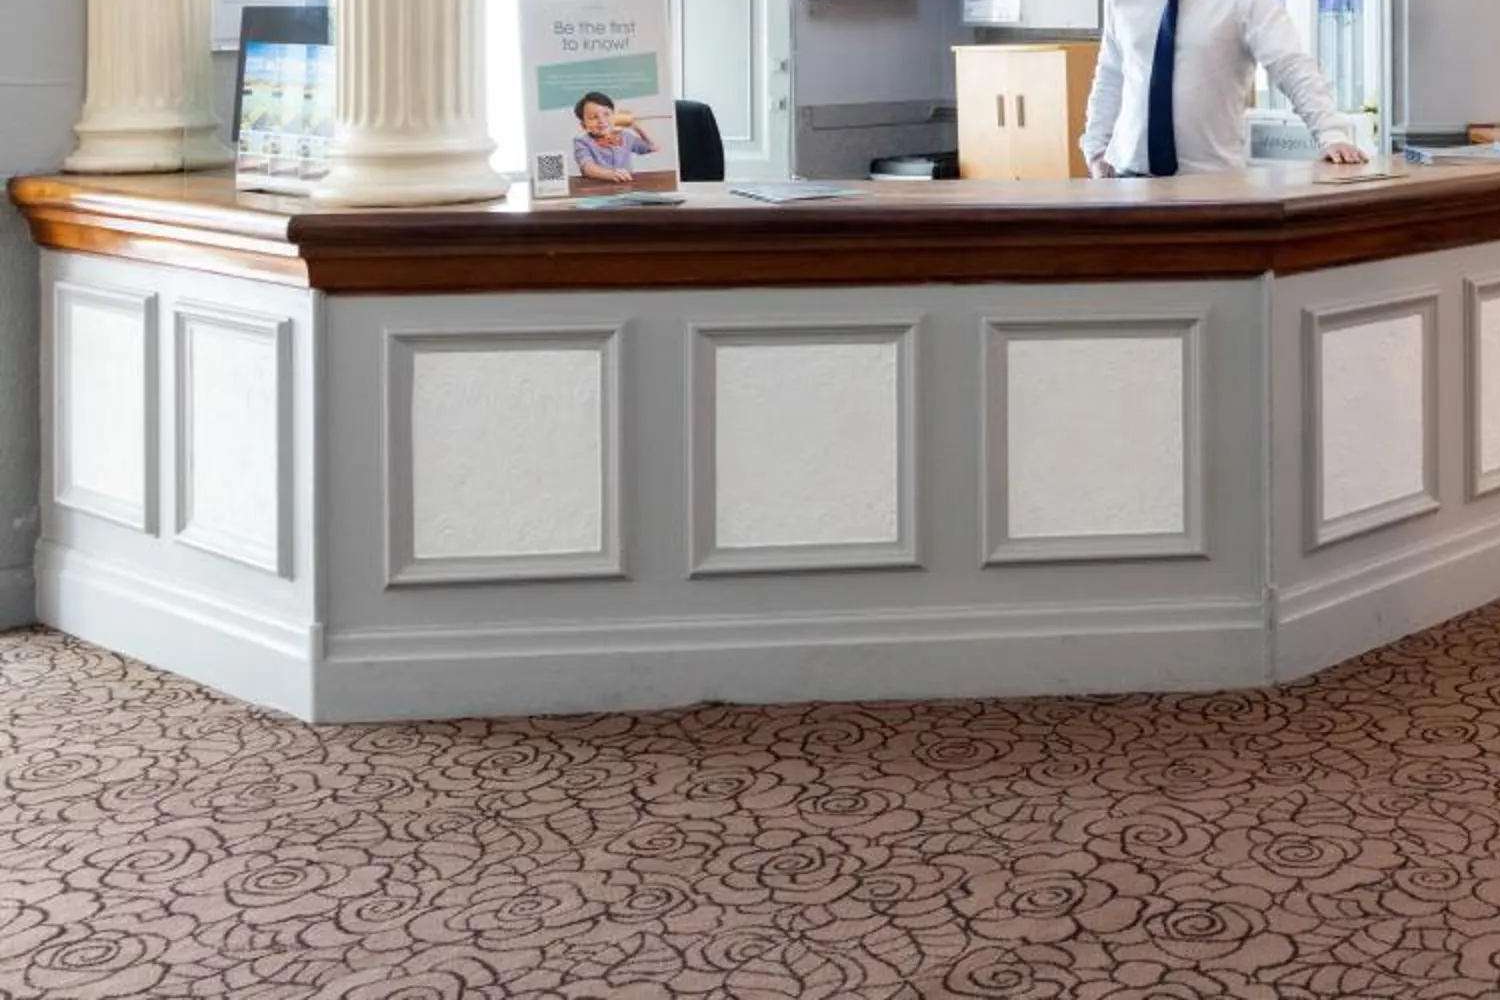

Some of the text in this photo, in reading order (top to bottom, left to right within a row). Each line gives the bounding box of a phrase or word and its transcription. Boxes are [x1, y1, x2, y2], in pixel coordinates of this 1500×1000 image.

[553, 20, 636, 35] Be the first
[561, 36, 630, 52] to know!
